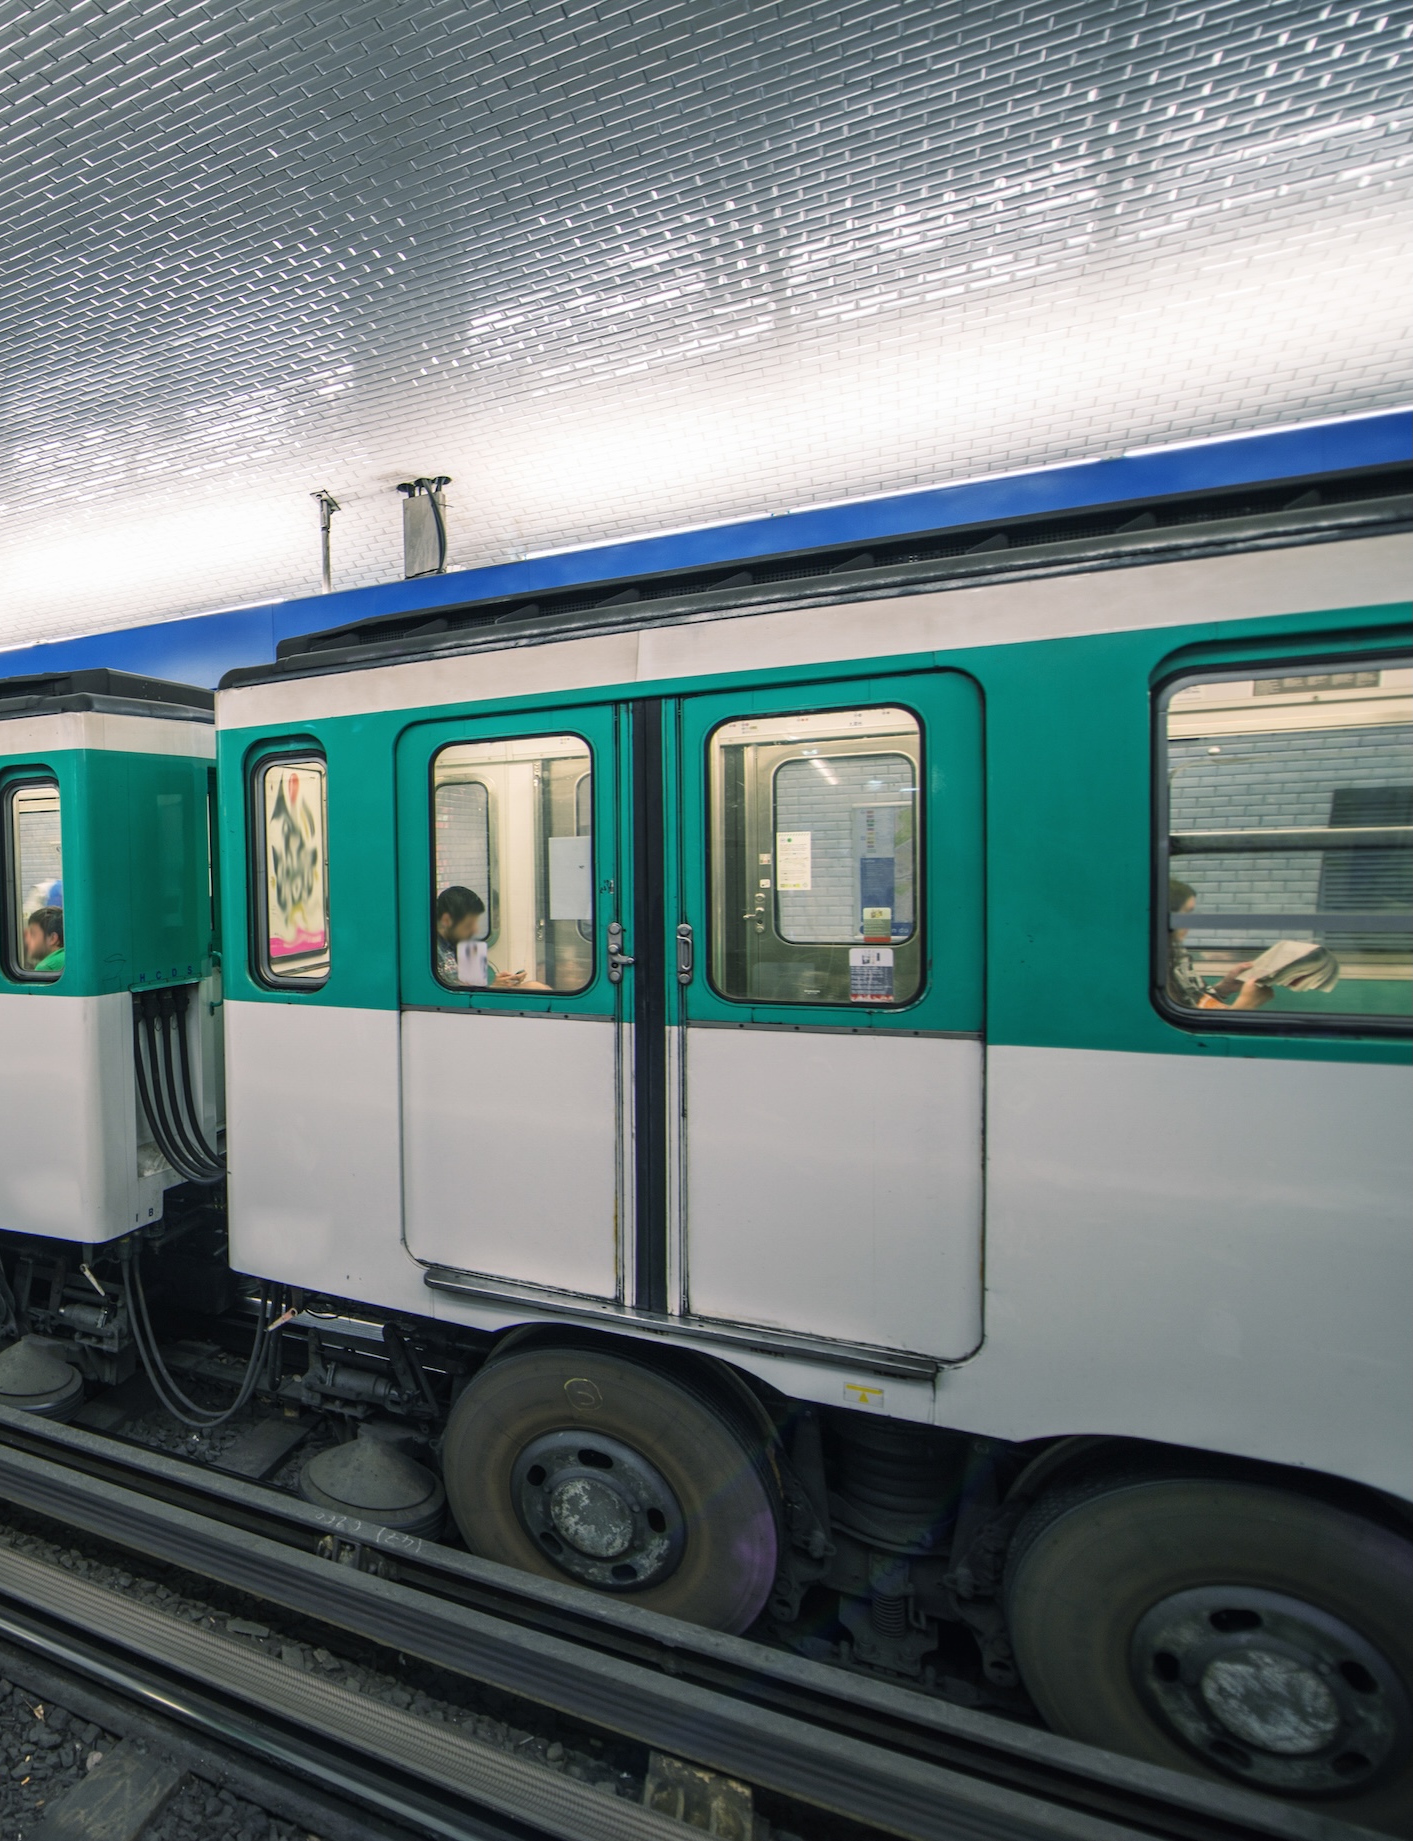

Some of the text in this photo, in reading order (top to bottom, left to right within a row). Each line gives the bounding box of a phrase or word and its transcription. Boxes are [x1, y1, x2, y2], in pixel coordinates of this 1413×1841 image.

[139, 965, 193, 983] H C D S
[148, 1207, 154, 1217] B
